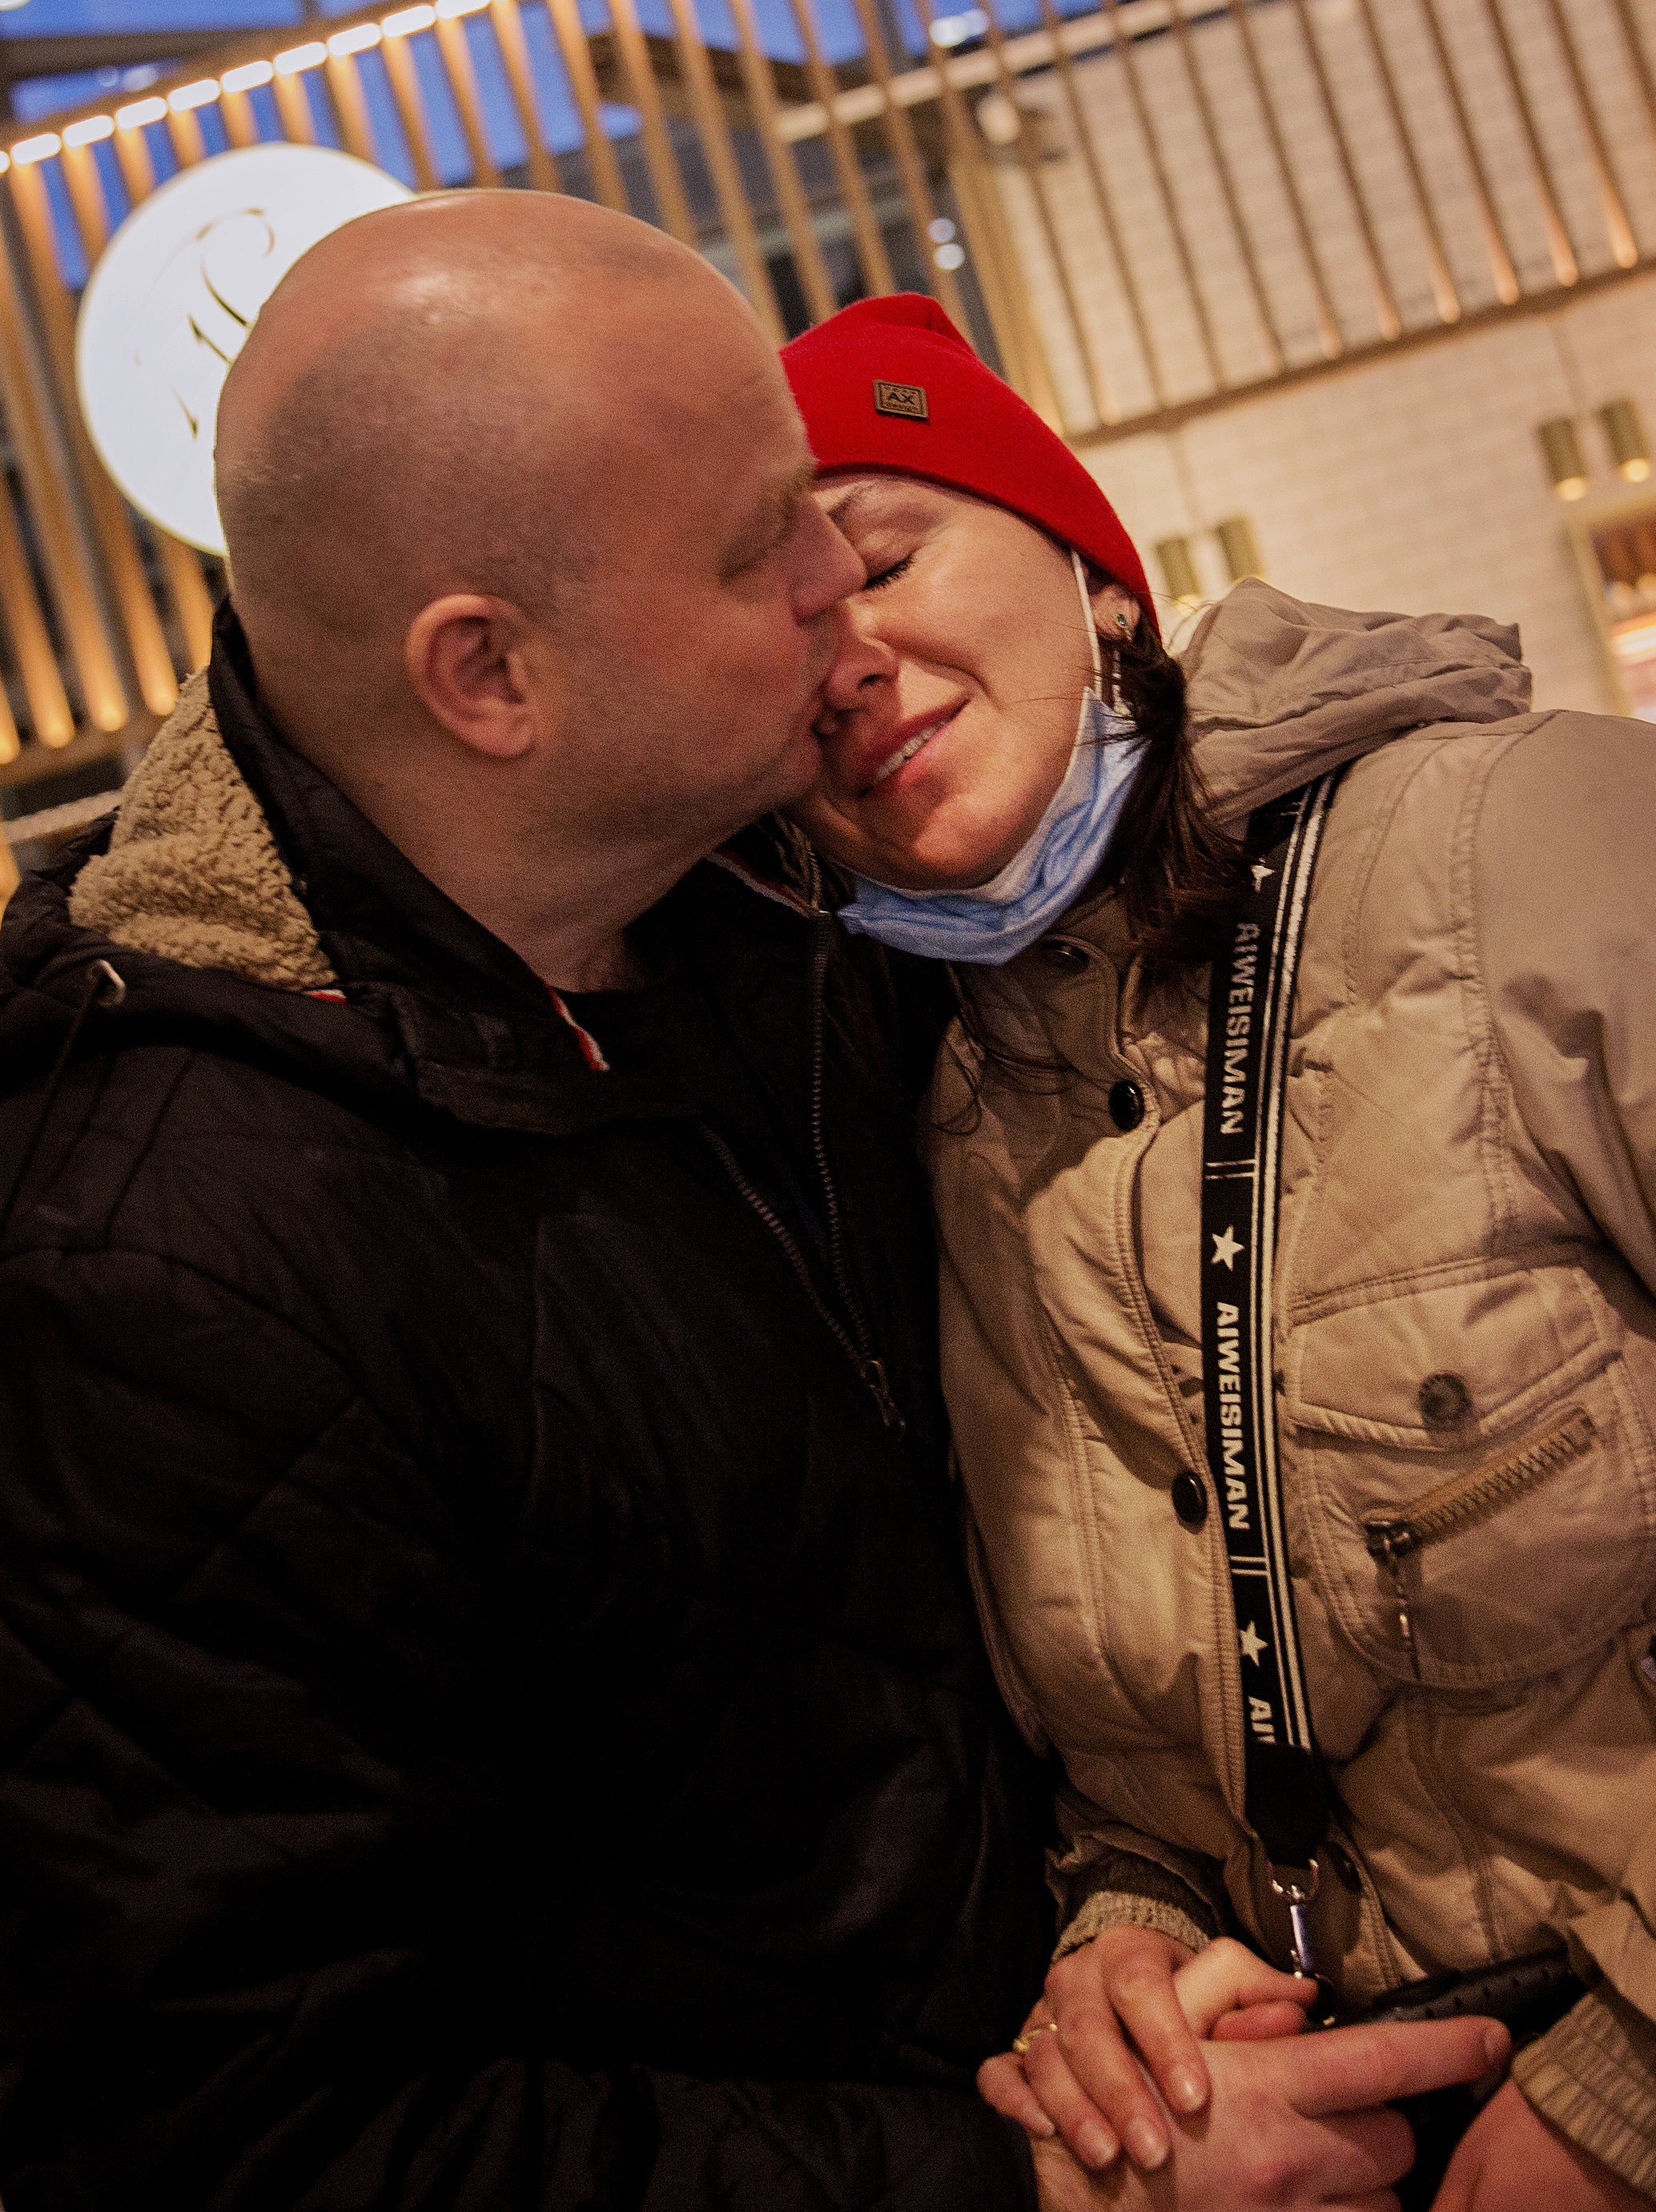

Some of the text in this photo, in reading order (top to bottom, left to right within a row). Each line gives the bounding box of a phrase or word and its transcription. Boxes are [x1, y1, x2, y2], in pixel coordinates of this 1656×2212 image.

[887, 392, 915, 405] AX
[1220, 923, 1261, 1134] AIWEISIMAN
[1216, 1301, 1250, 1530] AIWEISIMAN
